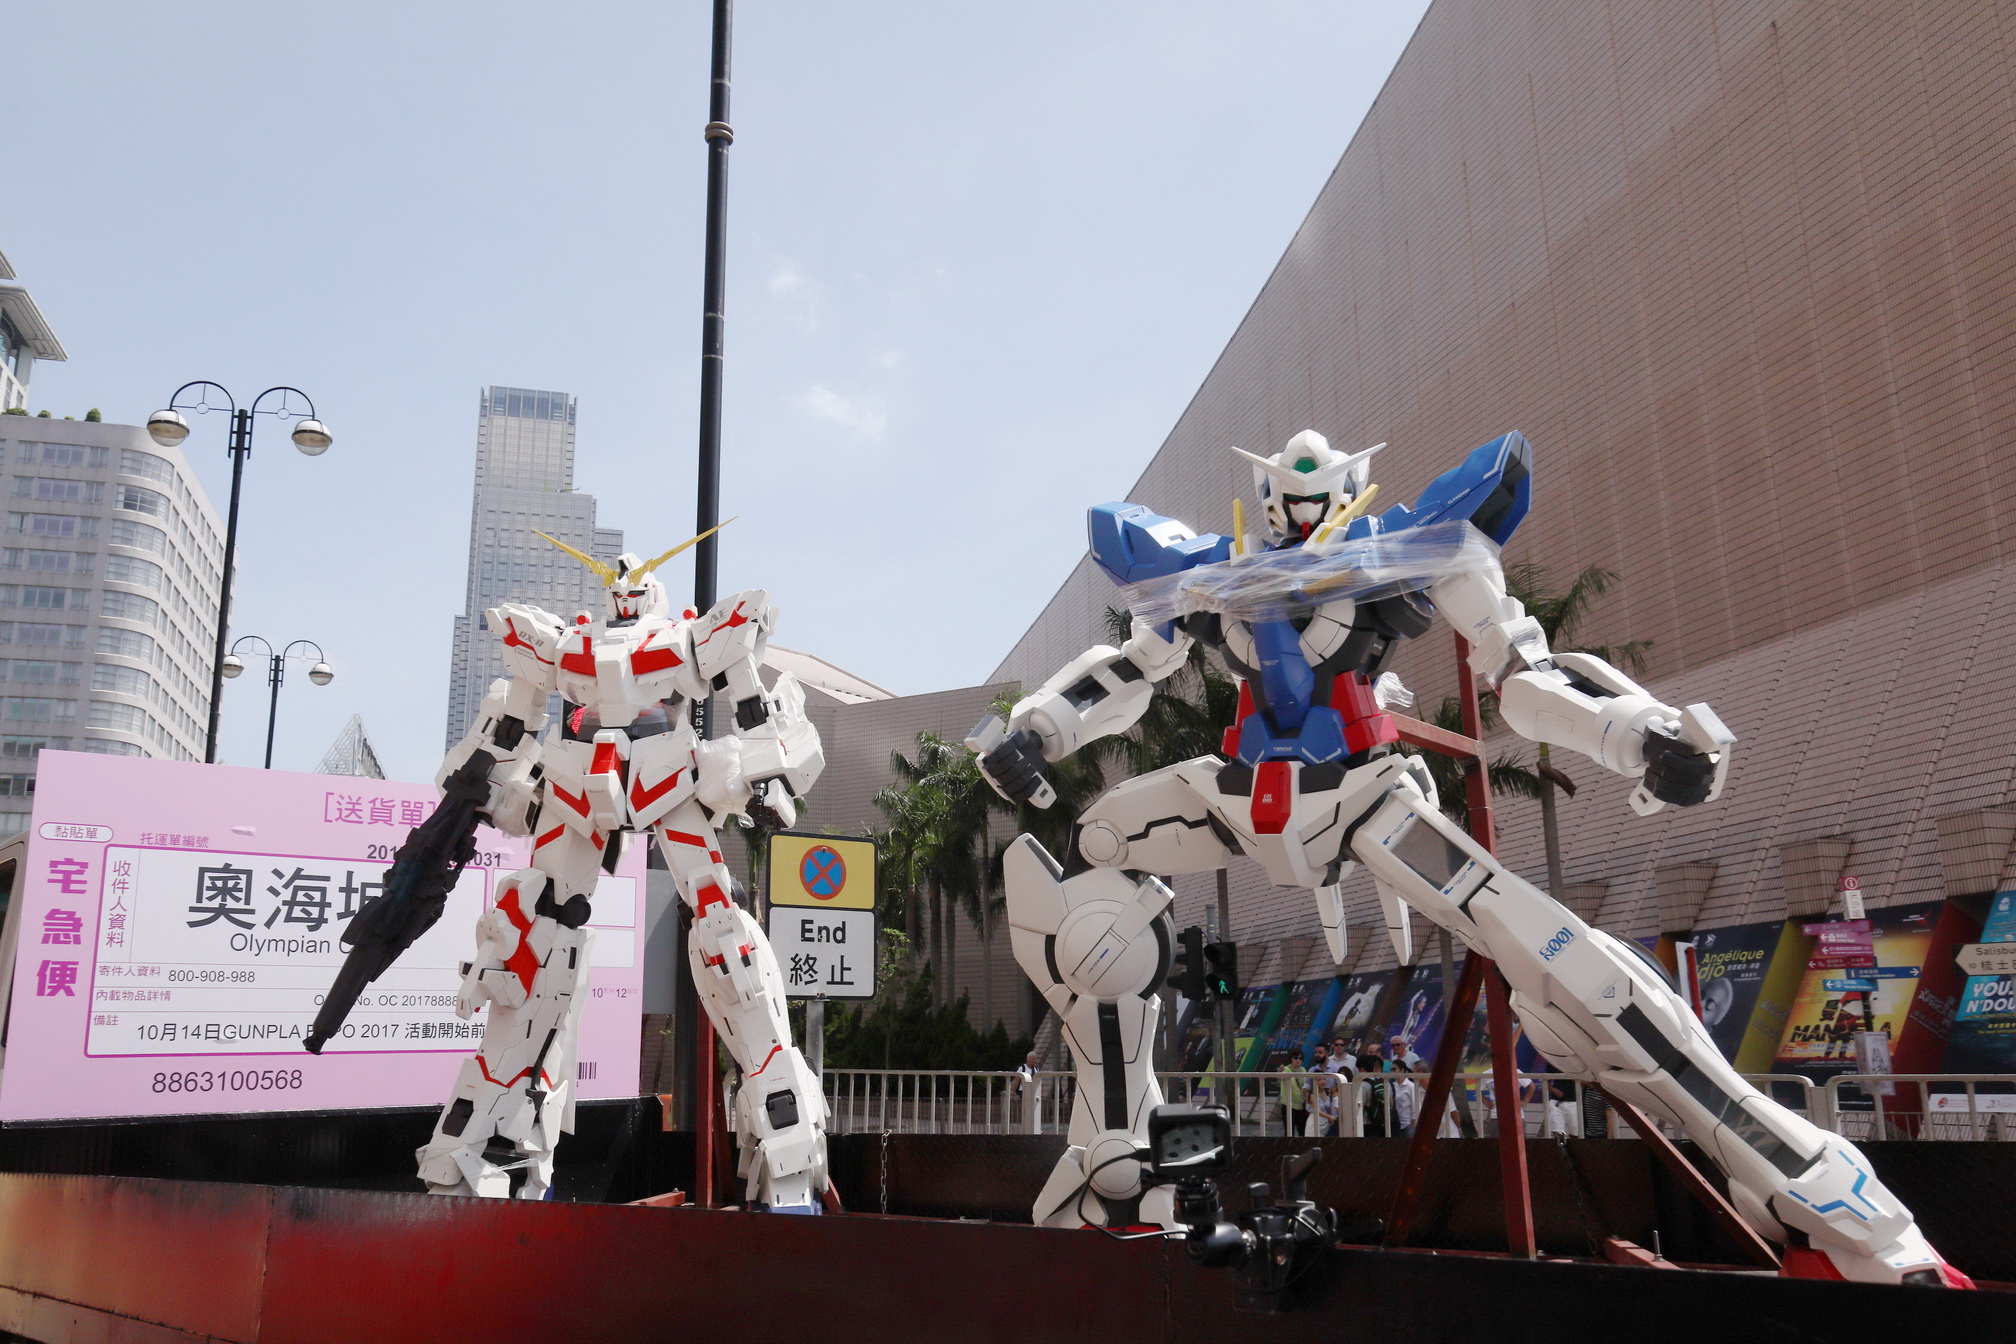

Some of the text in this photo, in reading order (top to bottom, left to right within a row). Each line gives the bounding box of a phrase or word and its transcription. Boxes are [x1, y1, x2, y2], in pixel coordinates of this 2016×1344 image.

[140, 832, 209, 848] 托運單編號
[106, 860, 132, 948] 收件人資料
[36, 857, 89, 997] 宅急便
[800, 919, 847, 944] End
[229, 932, 331, 957] Olympian
[1702, 950, 1764, 965] Angélique
[98, 965, 255, 983] 寄件人資料 800-908-988
[789, 953, 855, 986] 終止
[1697, 962, 1725, 982] djo
[96, 990, 171, 1001] 內載物品詳情
[1973, 981, 2013, 997] YOU
[378, 995, 398, 1006] OC
[93, 1015, 118, 1026] 備註
[138, 1023, 301, 1041] 10月14日GUNPLA
[361, 1024, 400, 1038] 2017
[404, 1023, 485, 1039] 活動開始前
[152, 1070, 303, 1093] 8863100568
